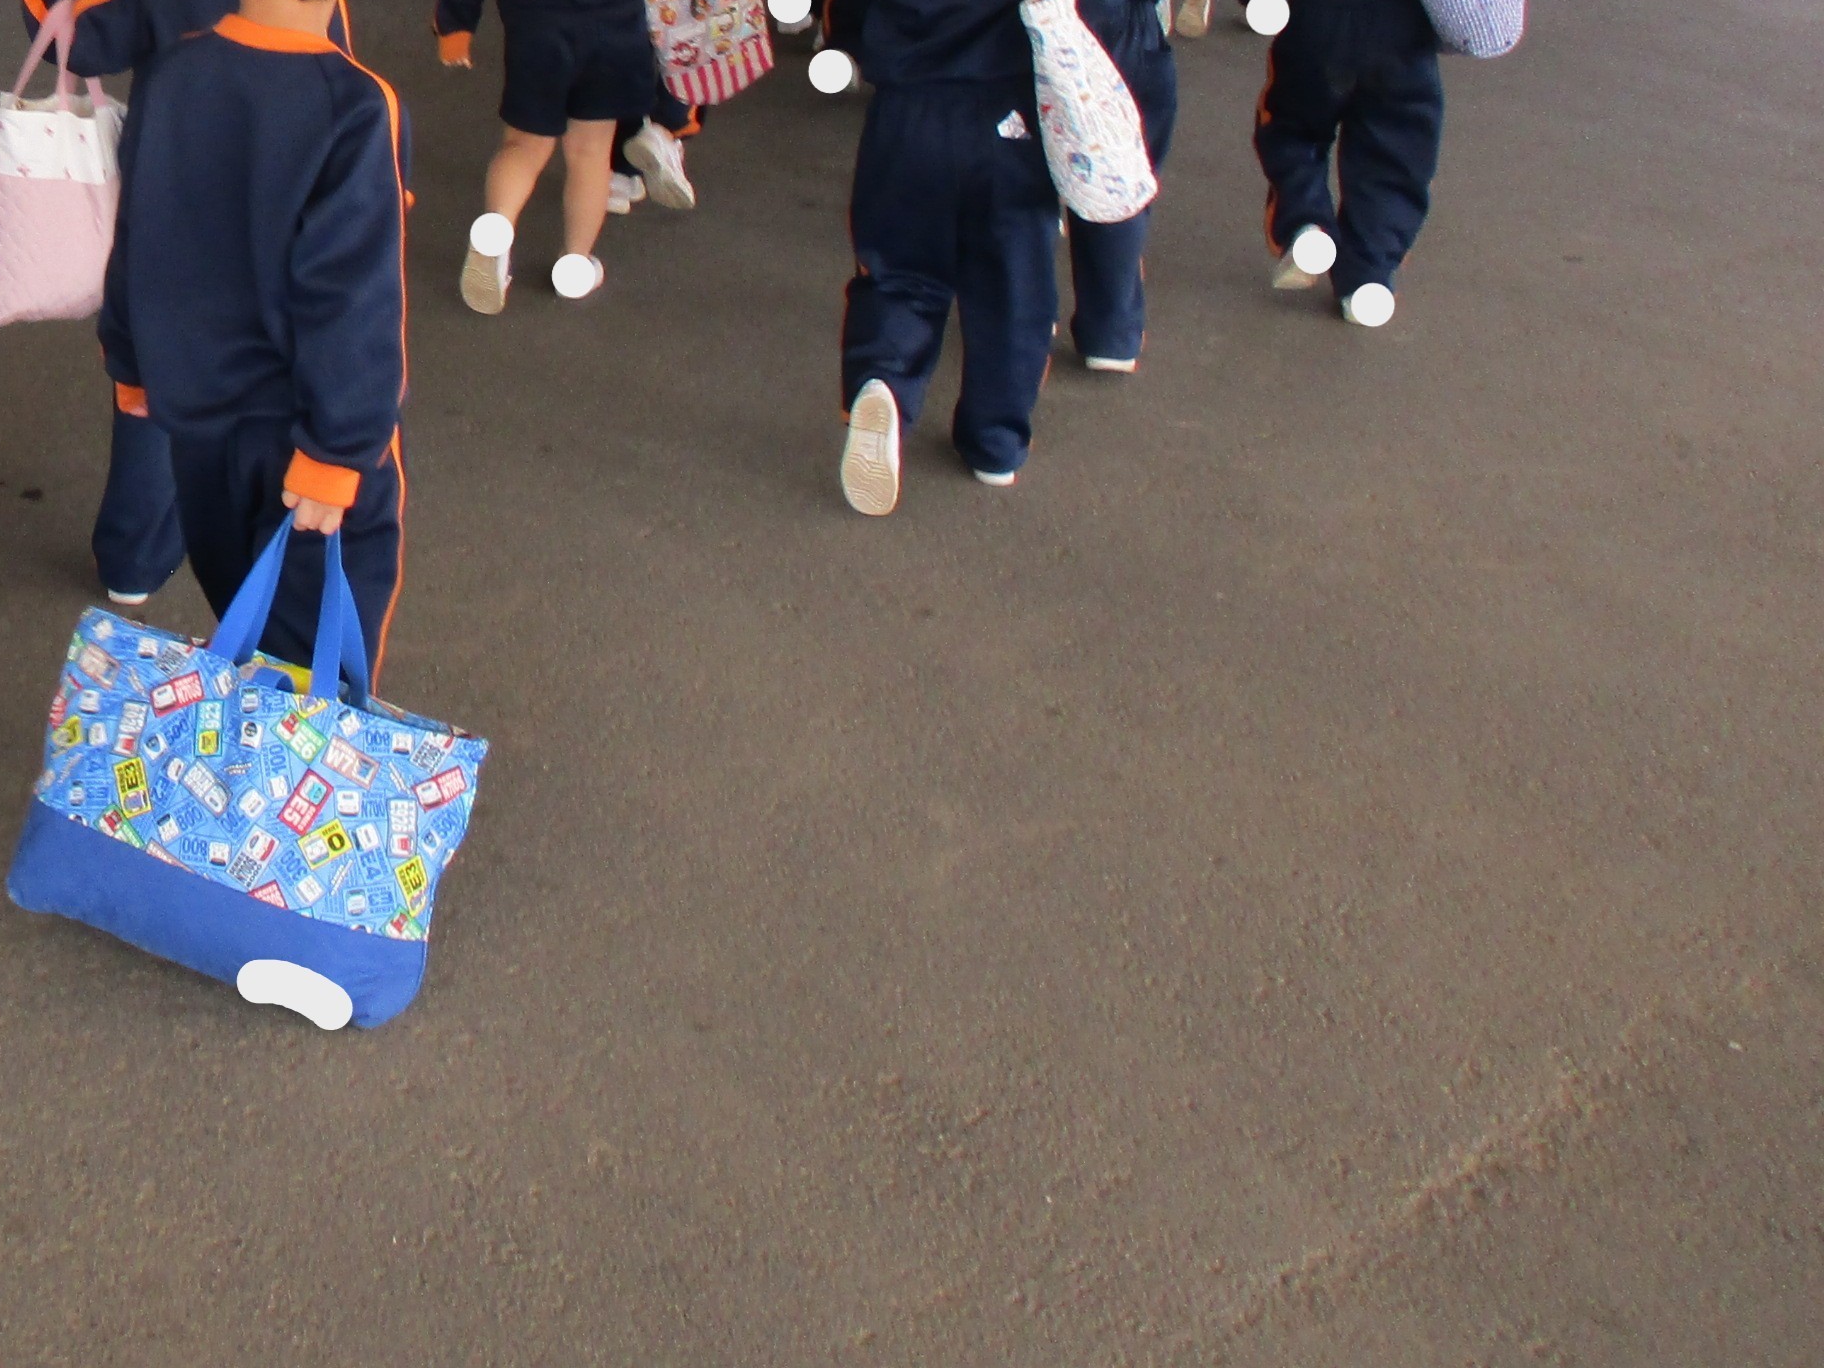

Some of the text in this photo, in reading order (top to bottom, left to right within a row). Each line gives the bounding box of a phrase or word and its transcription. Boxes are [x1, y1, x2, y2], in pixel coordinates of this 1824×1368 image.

[268, 744, 287, 774] 100
[288, 732, 320, 761] E6
[323, 746, 355, 773] W7
[122, 761, 141, 789] E3
[177, 806, 202, 829] 800
[282, 795, 310, 826] E5
[182, 838, 207, 855] 800
[281, 851, 307, 880] 300
[362, 851, 381, 881] E4
[404, 863, 422, 891] E3
